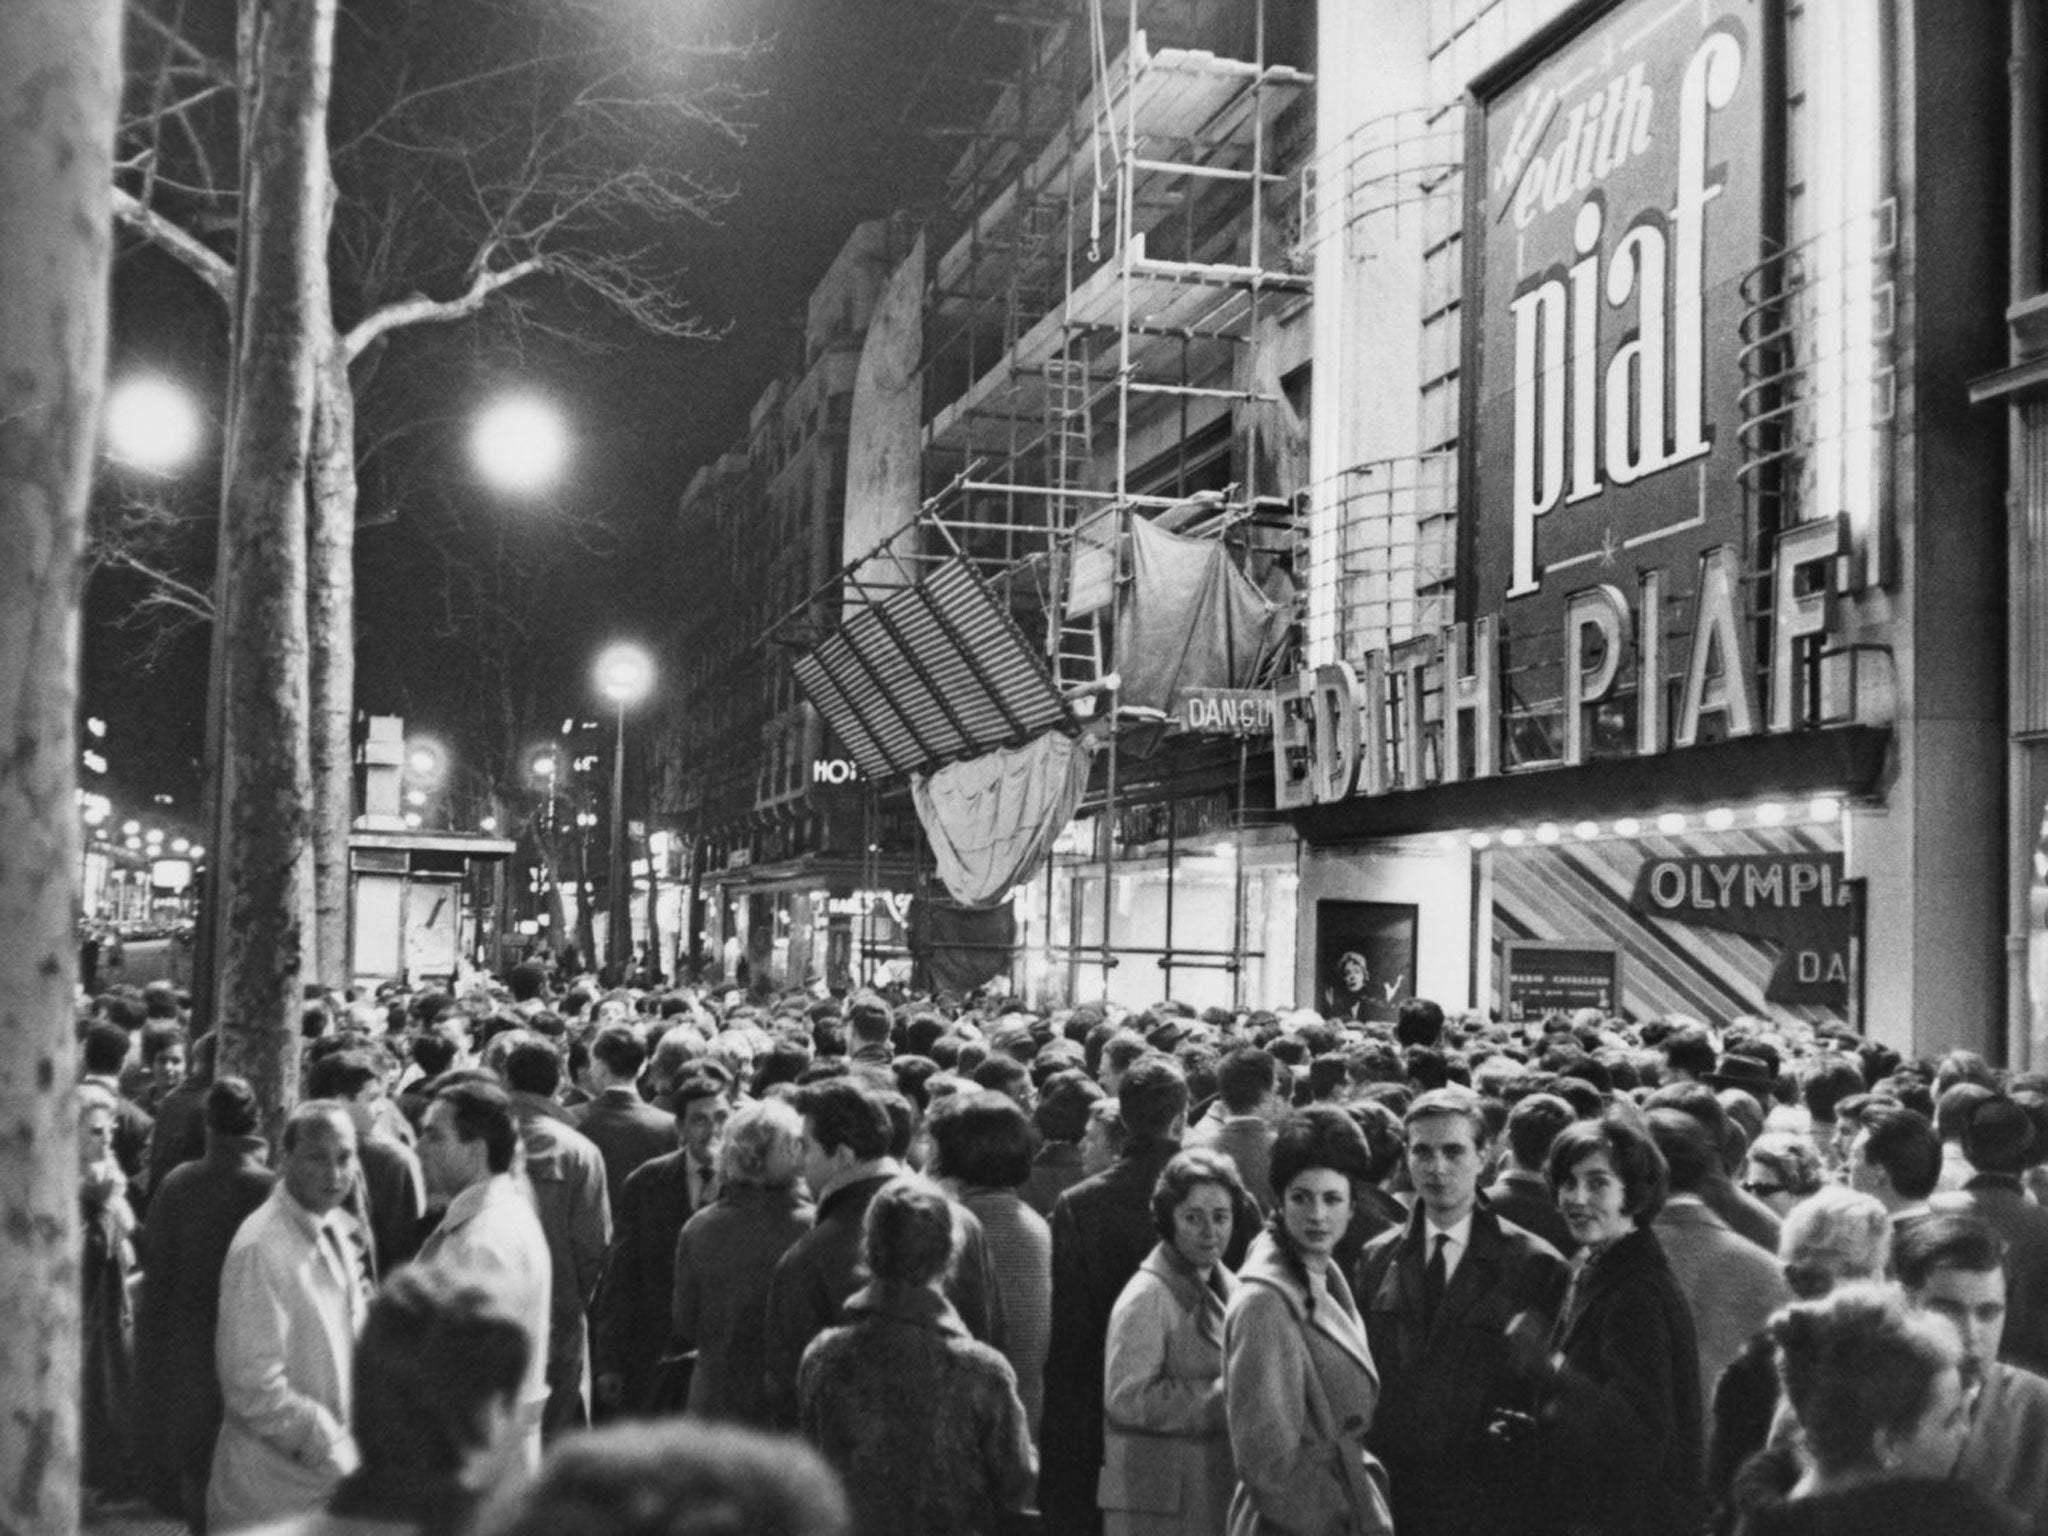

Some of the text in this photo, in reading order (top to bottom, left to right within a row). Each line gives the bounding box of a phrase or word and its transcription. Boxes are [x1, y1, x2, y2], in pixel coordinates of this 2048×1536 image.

[1507, 31, 1742, 598] piaf
[1274, 514, 1846, 811] EDITH PIAF
